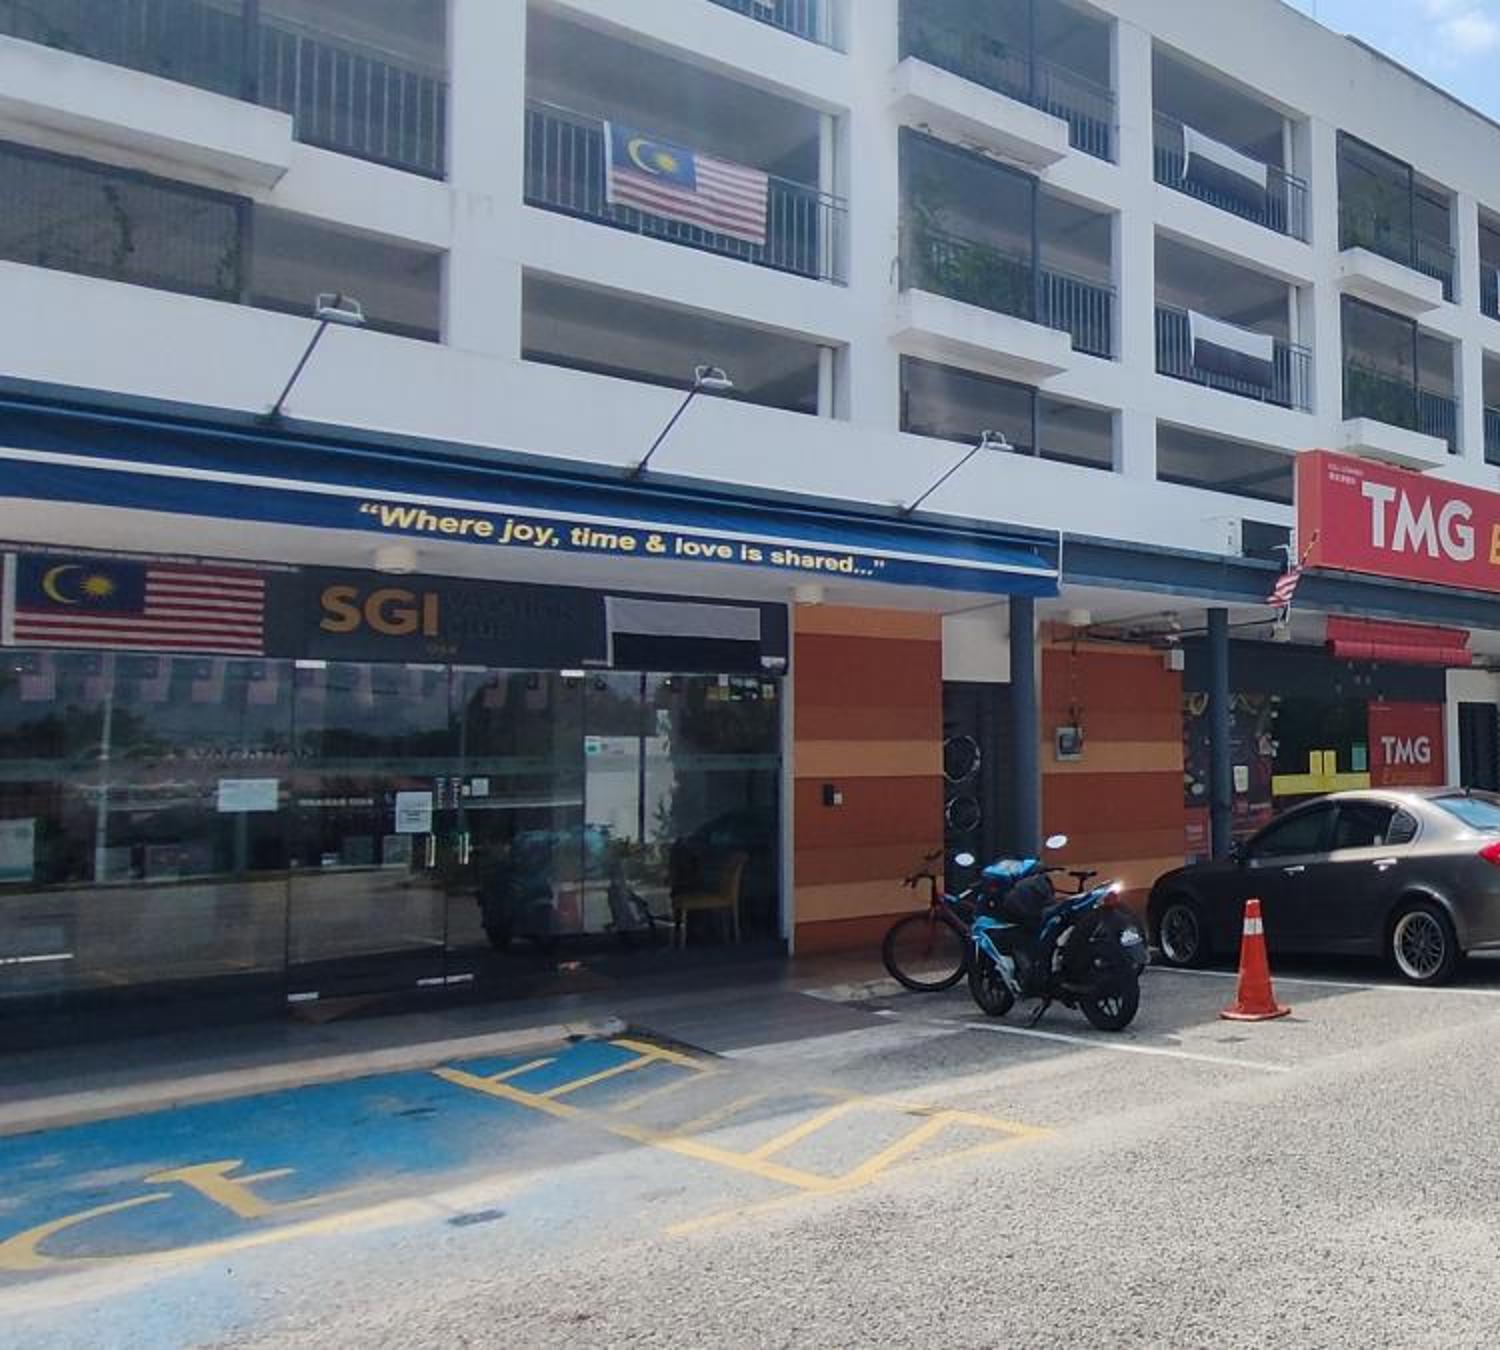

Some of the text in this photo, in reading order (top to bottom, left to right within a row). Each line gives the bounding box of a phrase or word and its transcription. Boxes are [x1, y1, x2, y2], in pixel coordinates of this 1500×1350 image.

[500, 518, 560, 547] joy,
[570, 527, 636, 551] time
[645, 534, 666, 553] &
[675, 536, 733, 559] love
[741, 543, 763, 562] is
[1361, 480, 1476, 562] TMG
[320, 584, 439, 637] SGI
[1381, 735, 1431, 765] TMG
